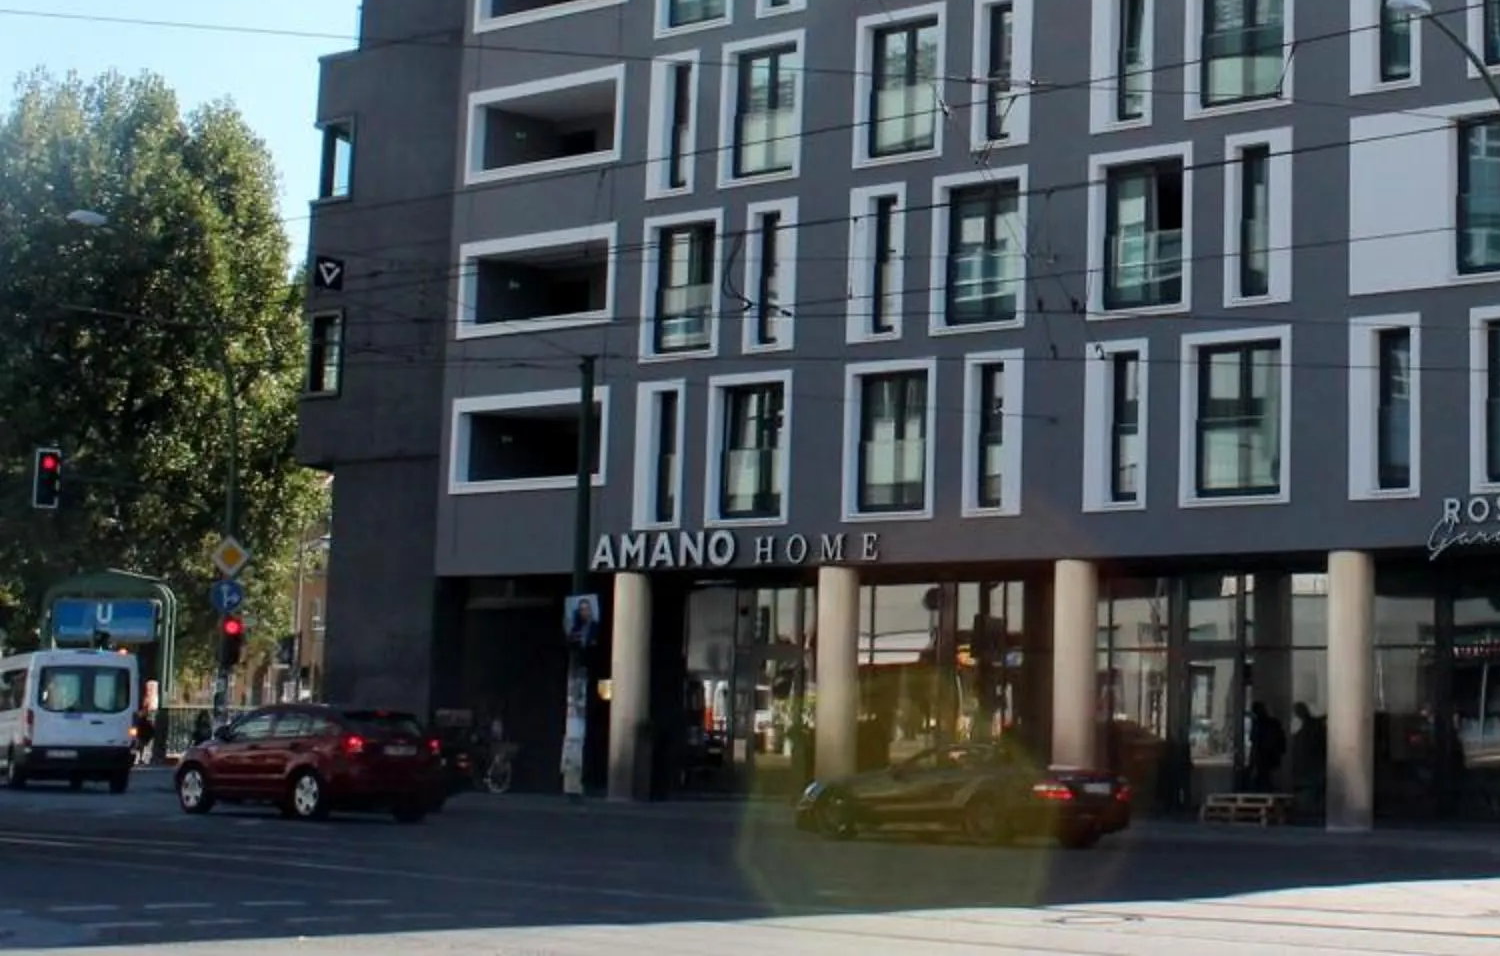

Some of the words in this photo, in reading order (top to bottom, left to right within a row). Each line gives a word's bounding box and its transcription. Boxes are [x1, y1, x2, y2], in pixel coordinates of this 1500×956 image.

[591, 530, 734, 569] AMANO
[754, 533, 879, 563] HOME
[96, 602, 113, 624] U
